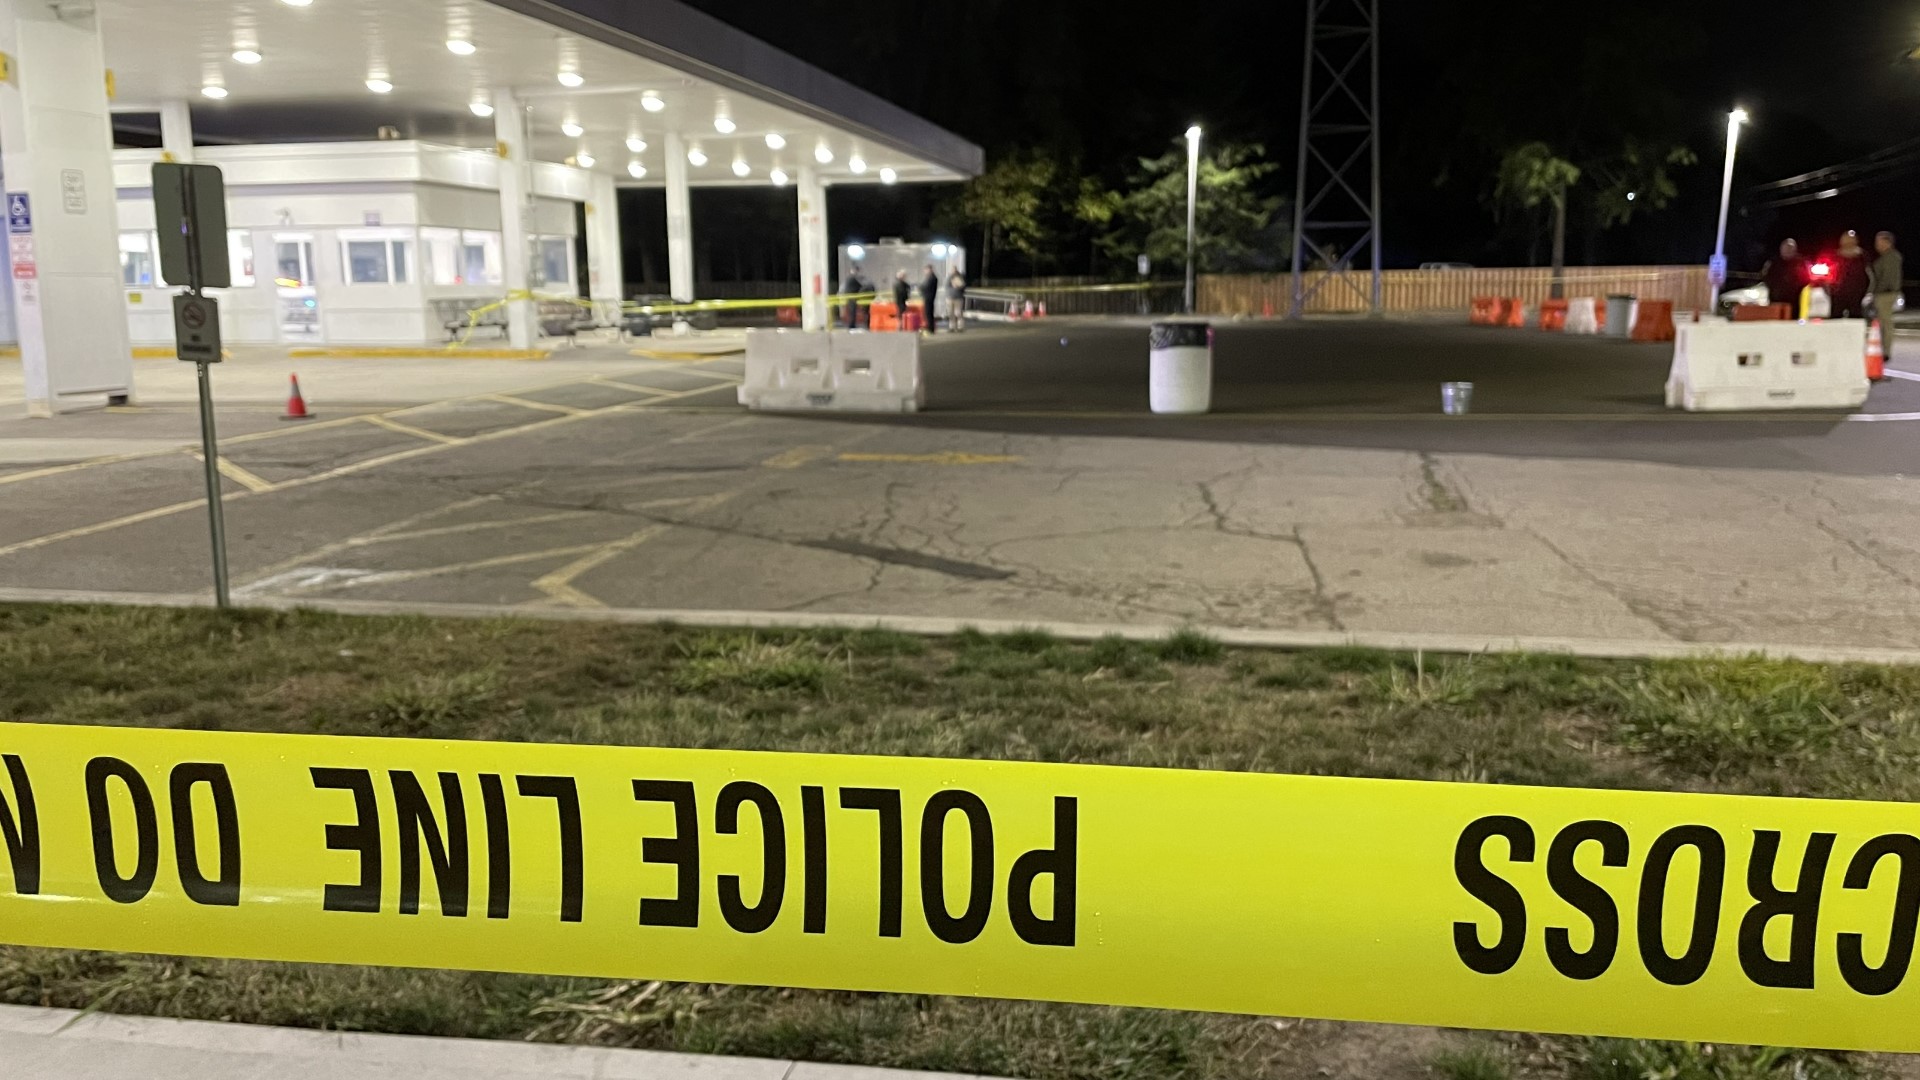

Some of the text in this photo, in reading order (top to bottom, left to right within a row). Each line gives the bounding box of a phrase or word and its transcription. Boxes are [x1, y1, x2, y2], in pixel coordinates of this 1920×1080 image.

[85, 756, 241, 907] DO
[309, 766, 584, 923] LINE
[632, 779, 1078, 947] POLICE
[1453, 815, 1920, 996] CROSS
